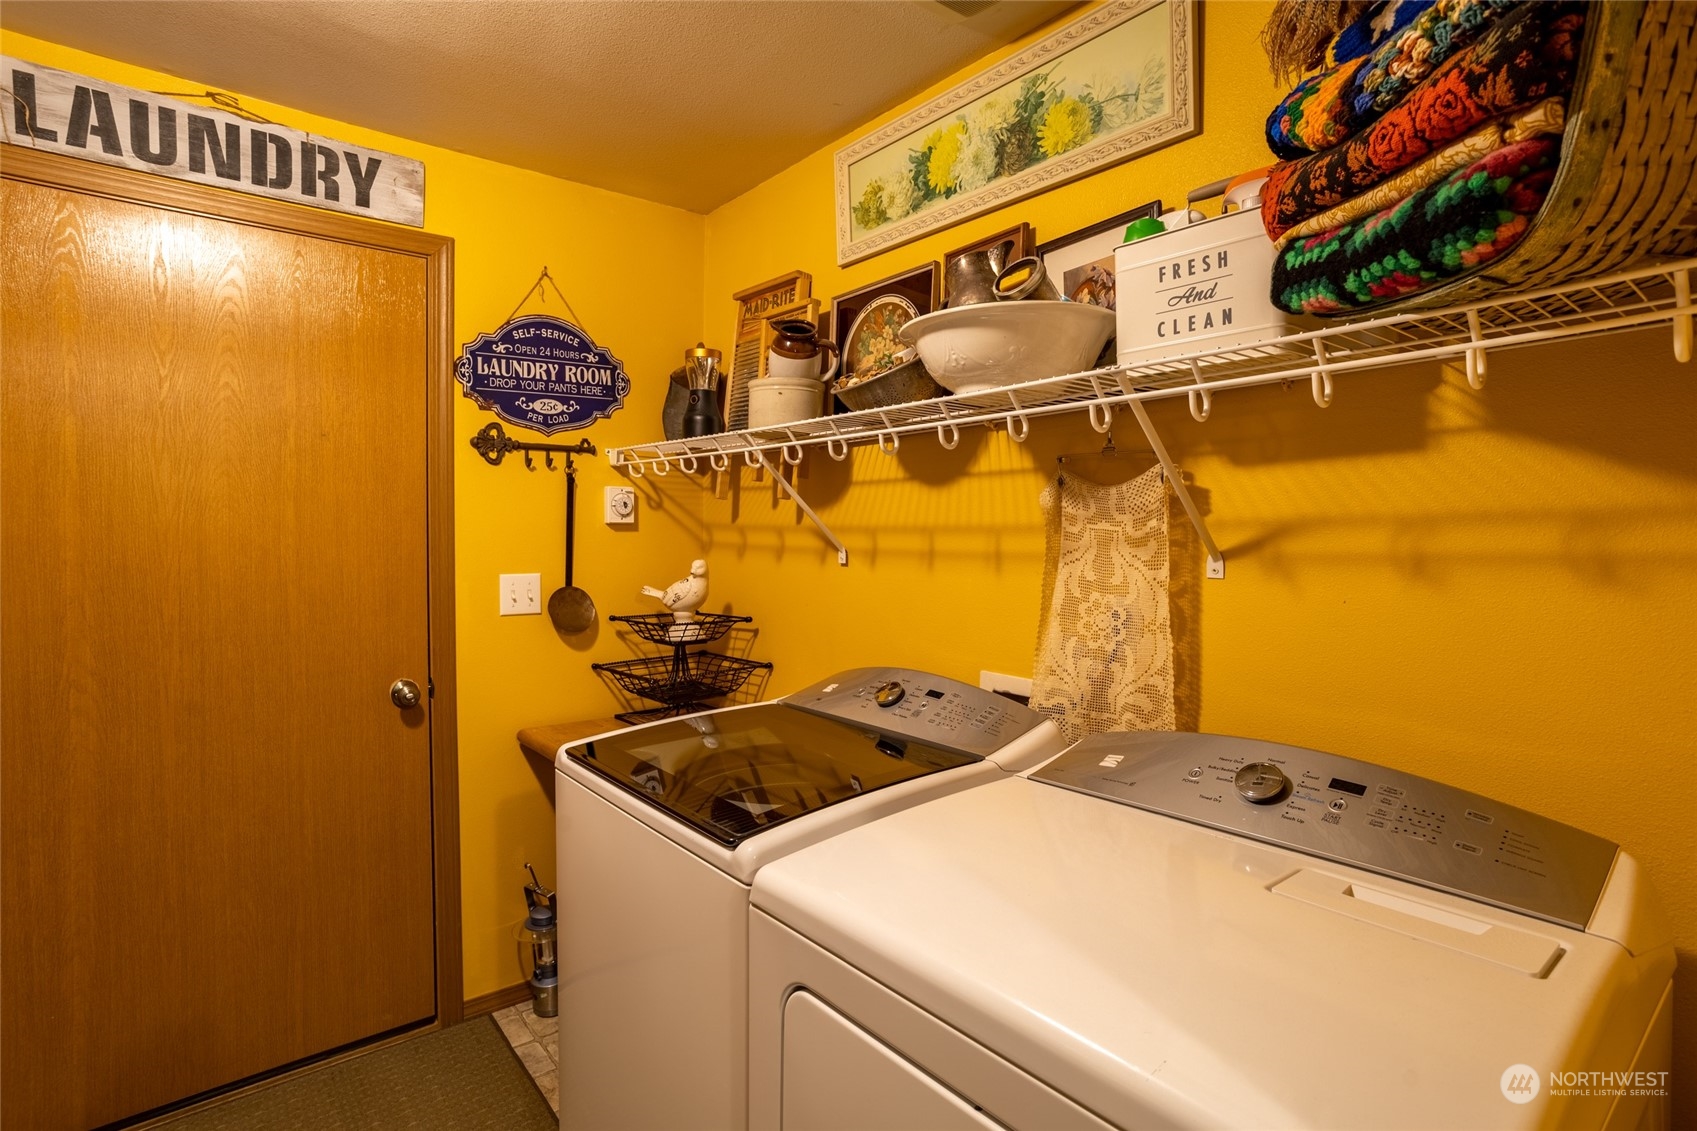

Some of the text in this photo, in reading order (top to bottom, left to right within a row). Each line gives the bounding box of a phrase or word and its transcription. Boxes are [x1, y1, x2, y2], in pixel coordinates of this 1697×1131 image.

[12, 68, 383, 209] LAUNDRY
[1158, 250, 1228, 283] FRESH
[743, 287, 796, 318] MAID-RITE
[1167, 281, 1218, 307] And
[1157, 307, 1233, 338] CLEAN
[513, 329, 580, 346] SELF-SERVICE
[514, 344, 580, 360] OPEN 24 HOURS
[477, 357, 612, 386] LAUNDRY ROOM
[519, 380, 545, 391] YOUR
[549, 382, 577, 394] PANTS
[527, 413, 570, 424] PER LOAD
